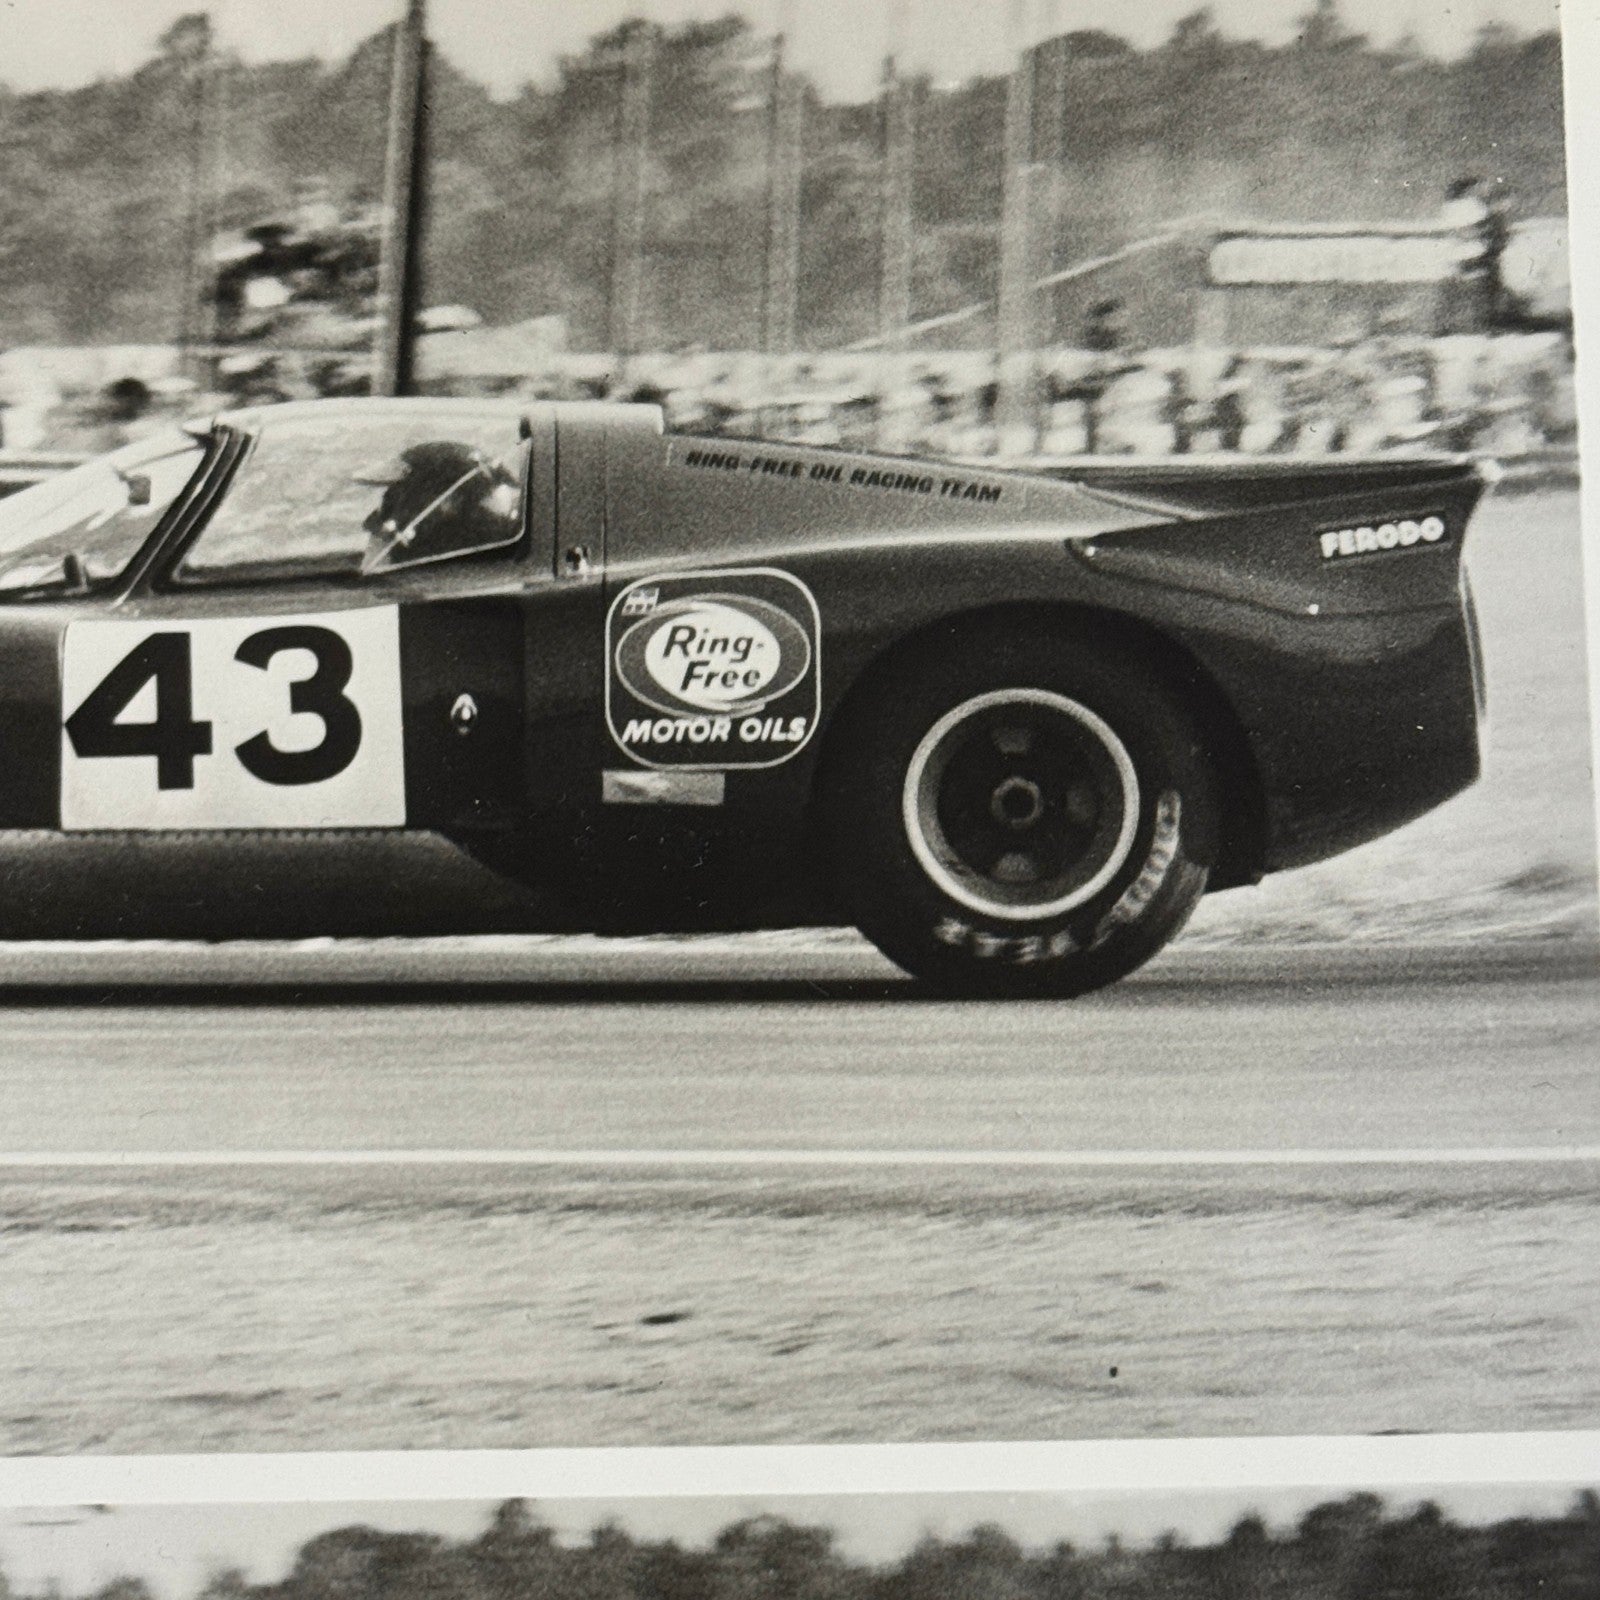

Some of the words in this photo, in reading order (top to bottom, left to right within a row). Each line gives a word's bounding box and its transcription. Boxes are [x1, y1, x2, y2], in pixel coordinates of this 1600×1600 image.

[809, 462, 843, 483] OIL
[849, 467, 934, 494] RACING
[940, 477, 1003, 504] TEAM
[1319, 516, 1445, 558] FERODO
[680, 660, 761, 691] Free
[64, 624, 362, 790] 43
[622, 716, 731, 744] MOTOR
[739, 716, 807, 742] OILS
